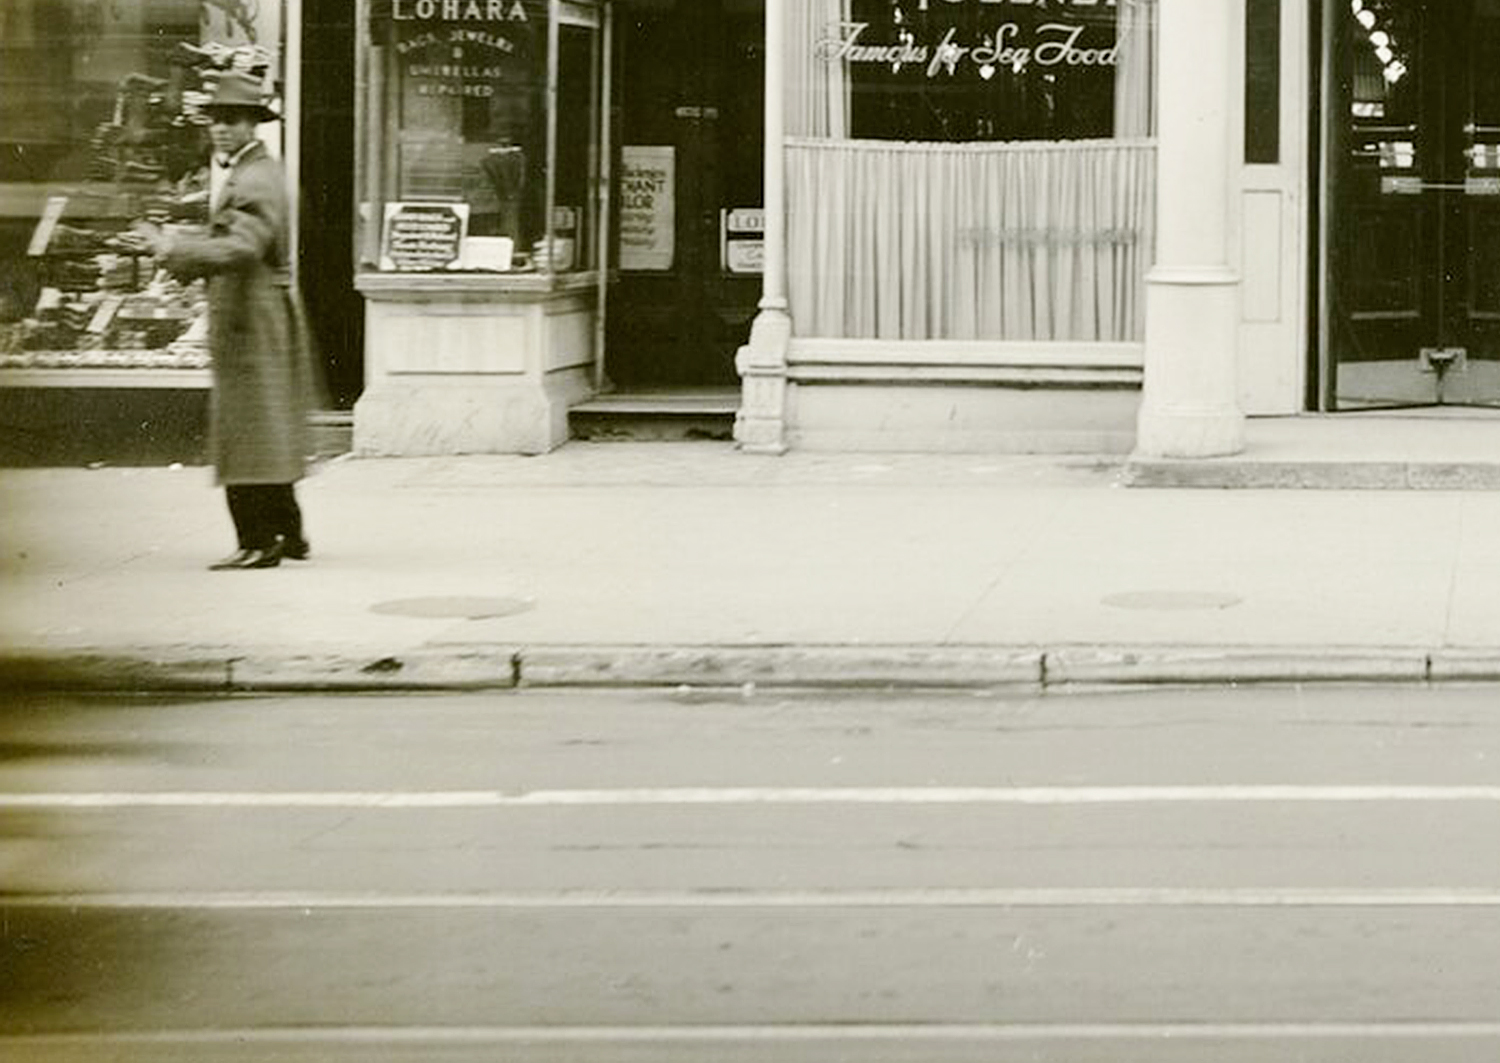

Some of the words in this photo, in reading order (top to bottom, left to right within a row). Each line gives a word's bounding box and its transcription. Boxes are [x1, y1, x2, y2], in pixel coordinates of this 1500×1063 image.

[815, 22, 928, 63] Famous
[926, 27, 971, 78] for
[971, 23, 1031, 66] Sea
[1034, 23, 1126, 66] Food
